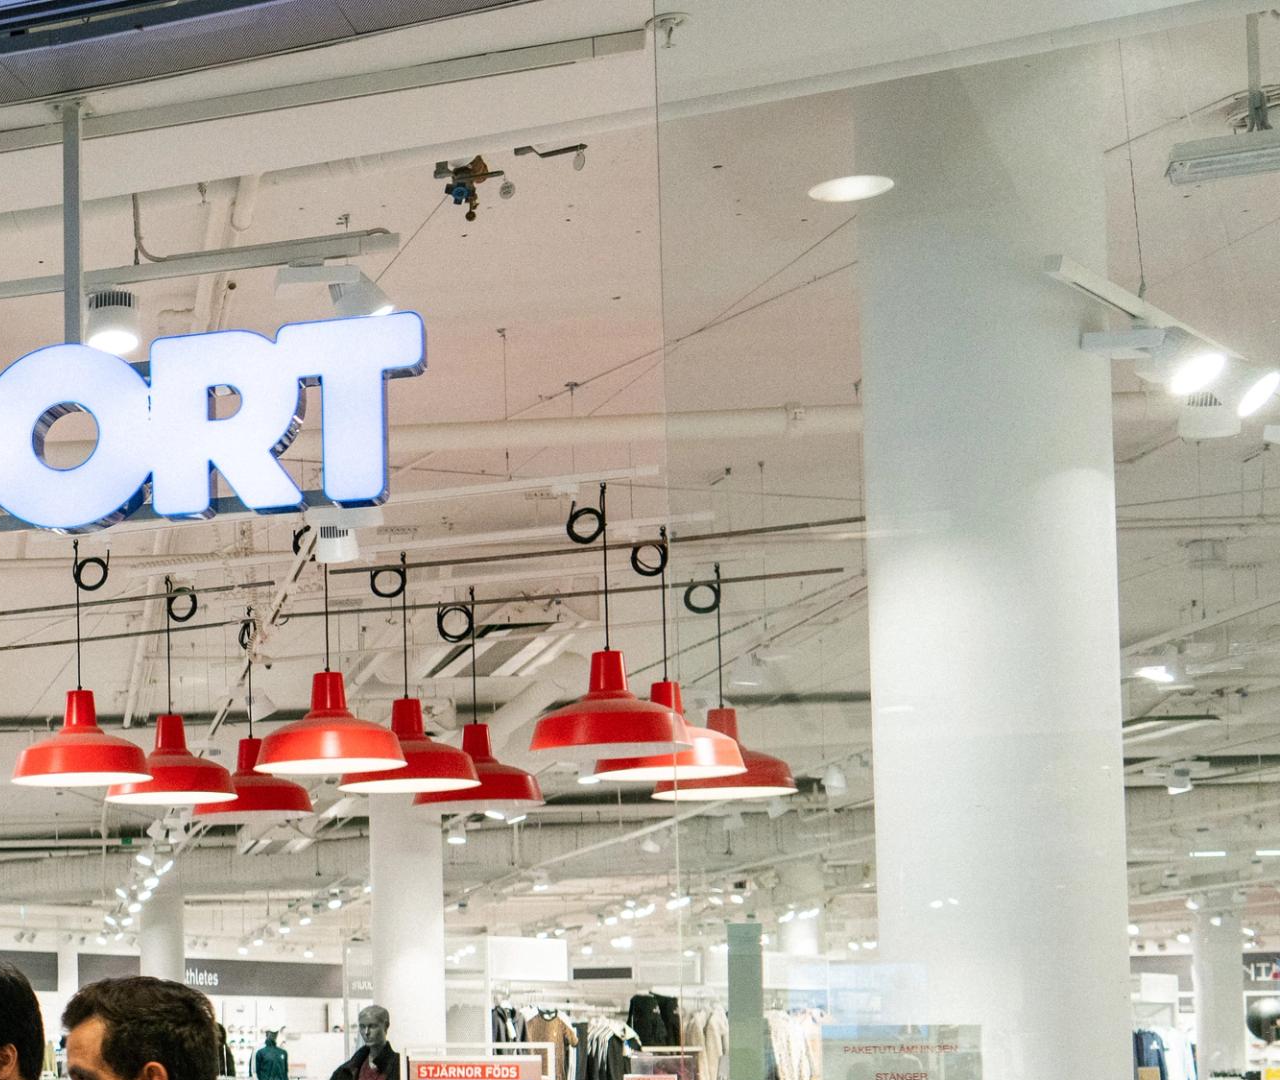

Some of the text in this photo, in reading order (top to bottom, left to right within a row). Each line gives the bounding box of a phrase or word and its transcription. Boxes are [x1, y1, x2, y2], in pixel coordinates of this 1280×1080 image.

[185, 968, 219, 986] thletes
[420, 1063, 517, 1078] STJÄRNOR FÖDS
